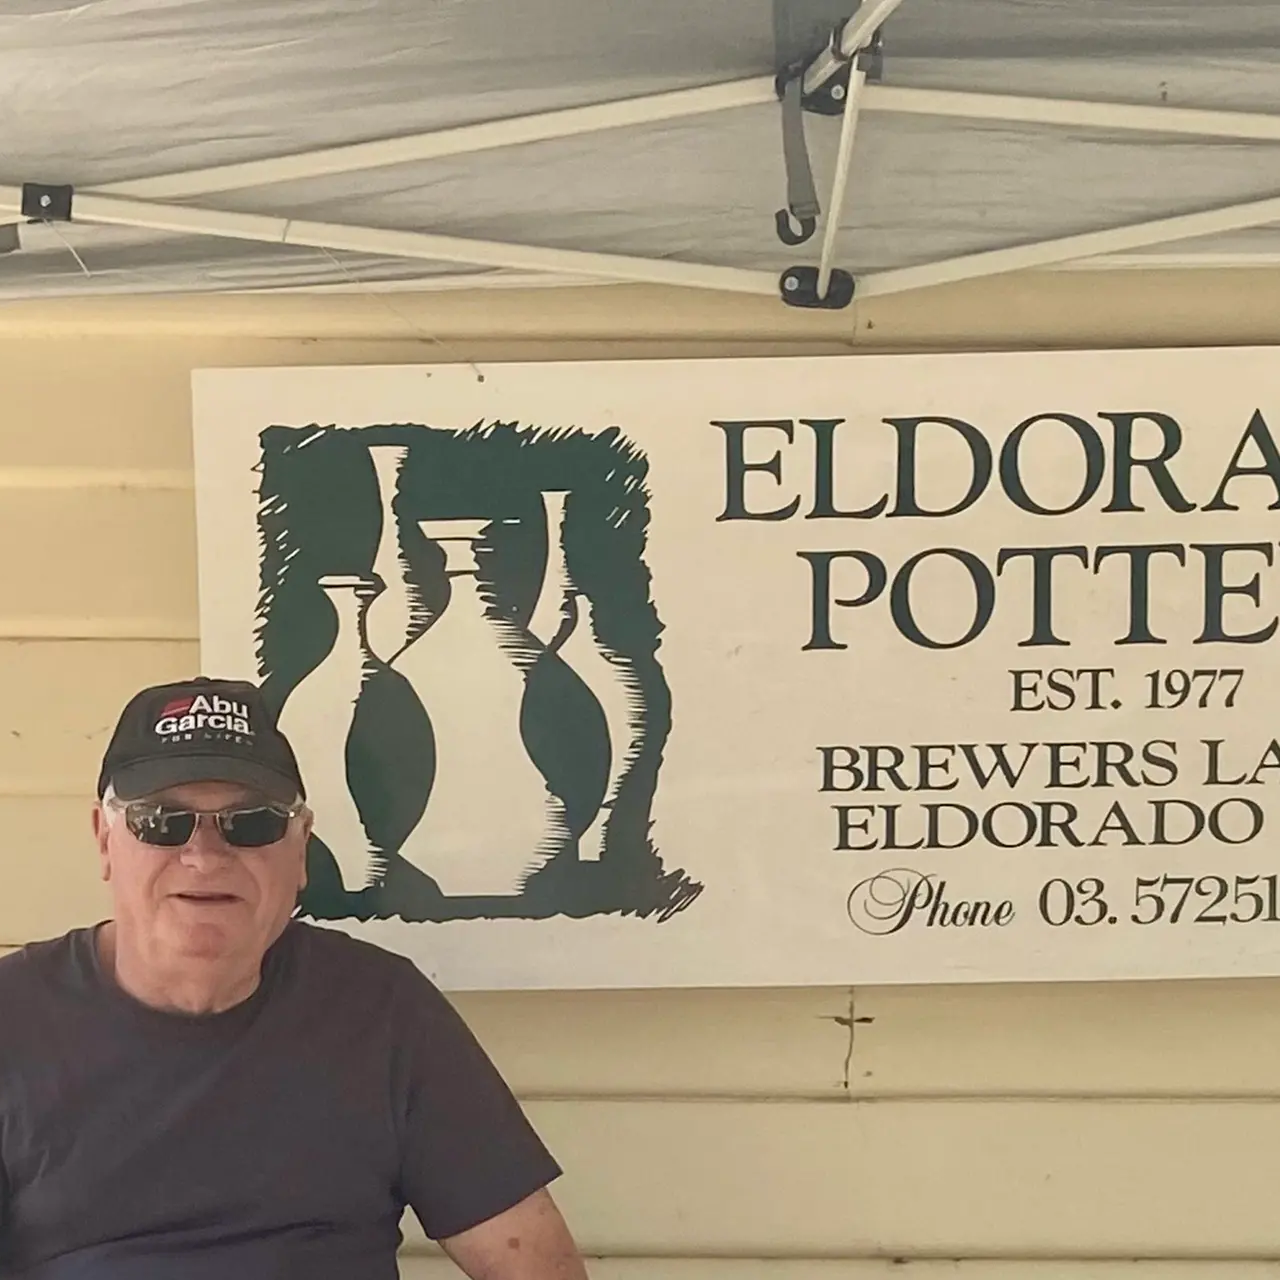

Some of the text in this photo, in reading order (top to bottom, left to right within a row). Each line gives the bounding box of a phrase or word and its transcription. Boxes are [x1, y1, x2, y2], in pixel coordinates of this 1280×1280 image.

[188, 694, 249, 719] Abu
[1008, 668, 1244, 712] EST. 1977
[155, 714, 251, 735] Garcia
[815, 739, 1178, 793] BREWERS
[830, 797, 1264, 851] ELDORADO
[846, 867, 1016, 936] Phone
